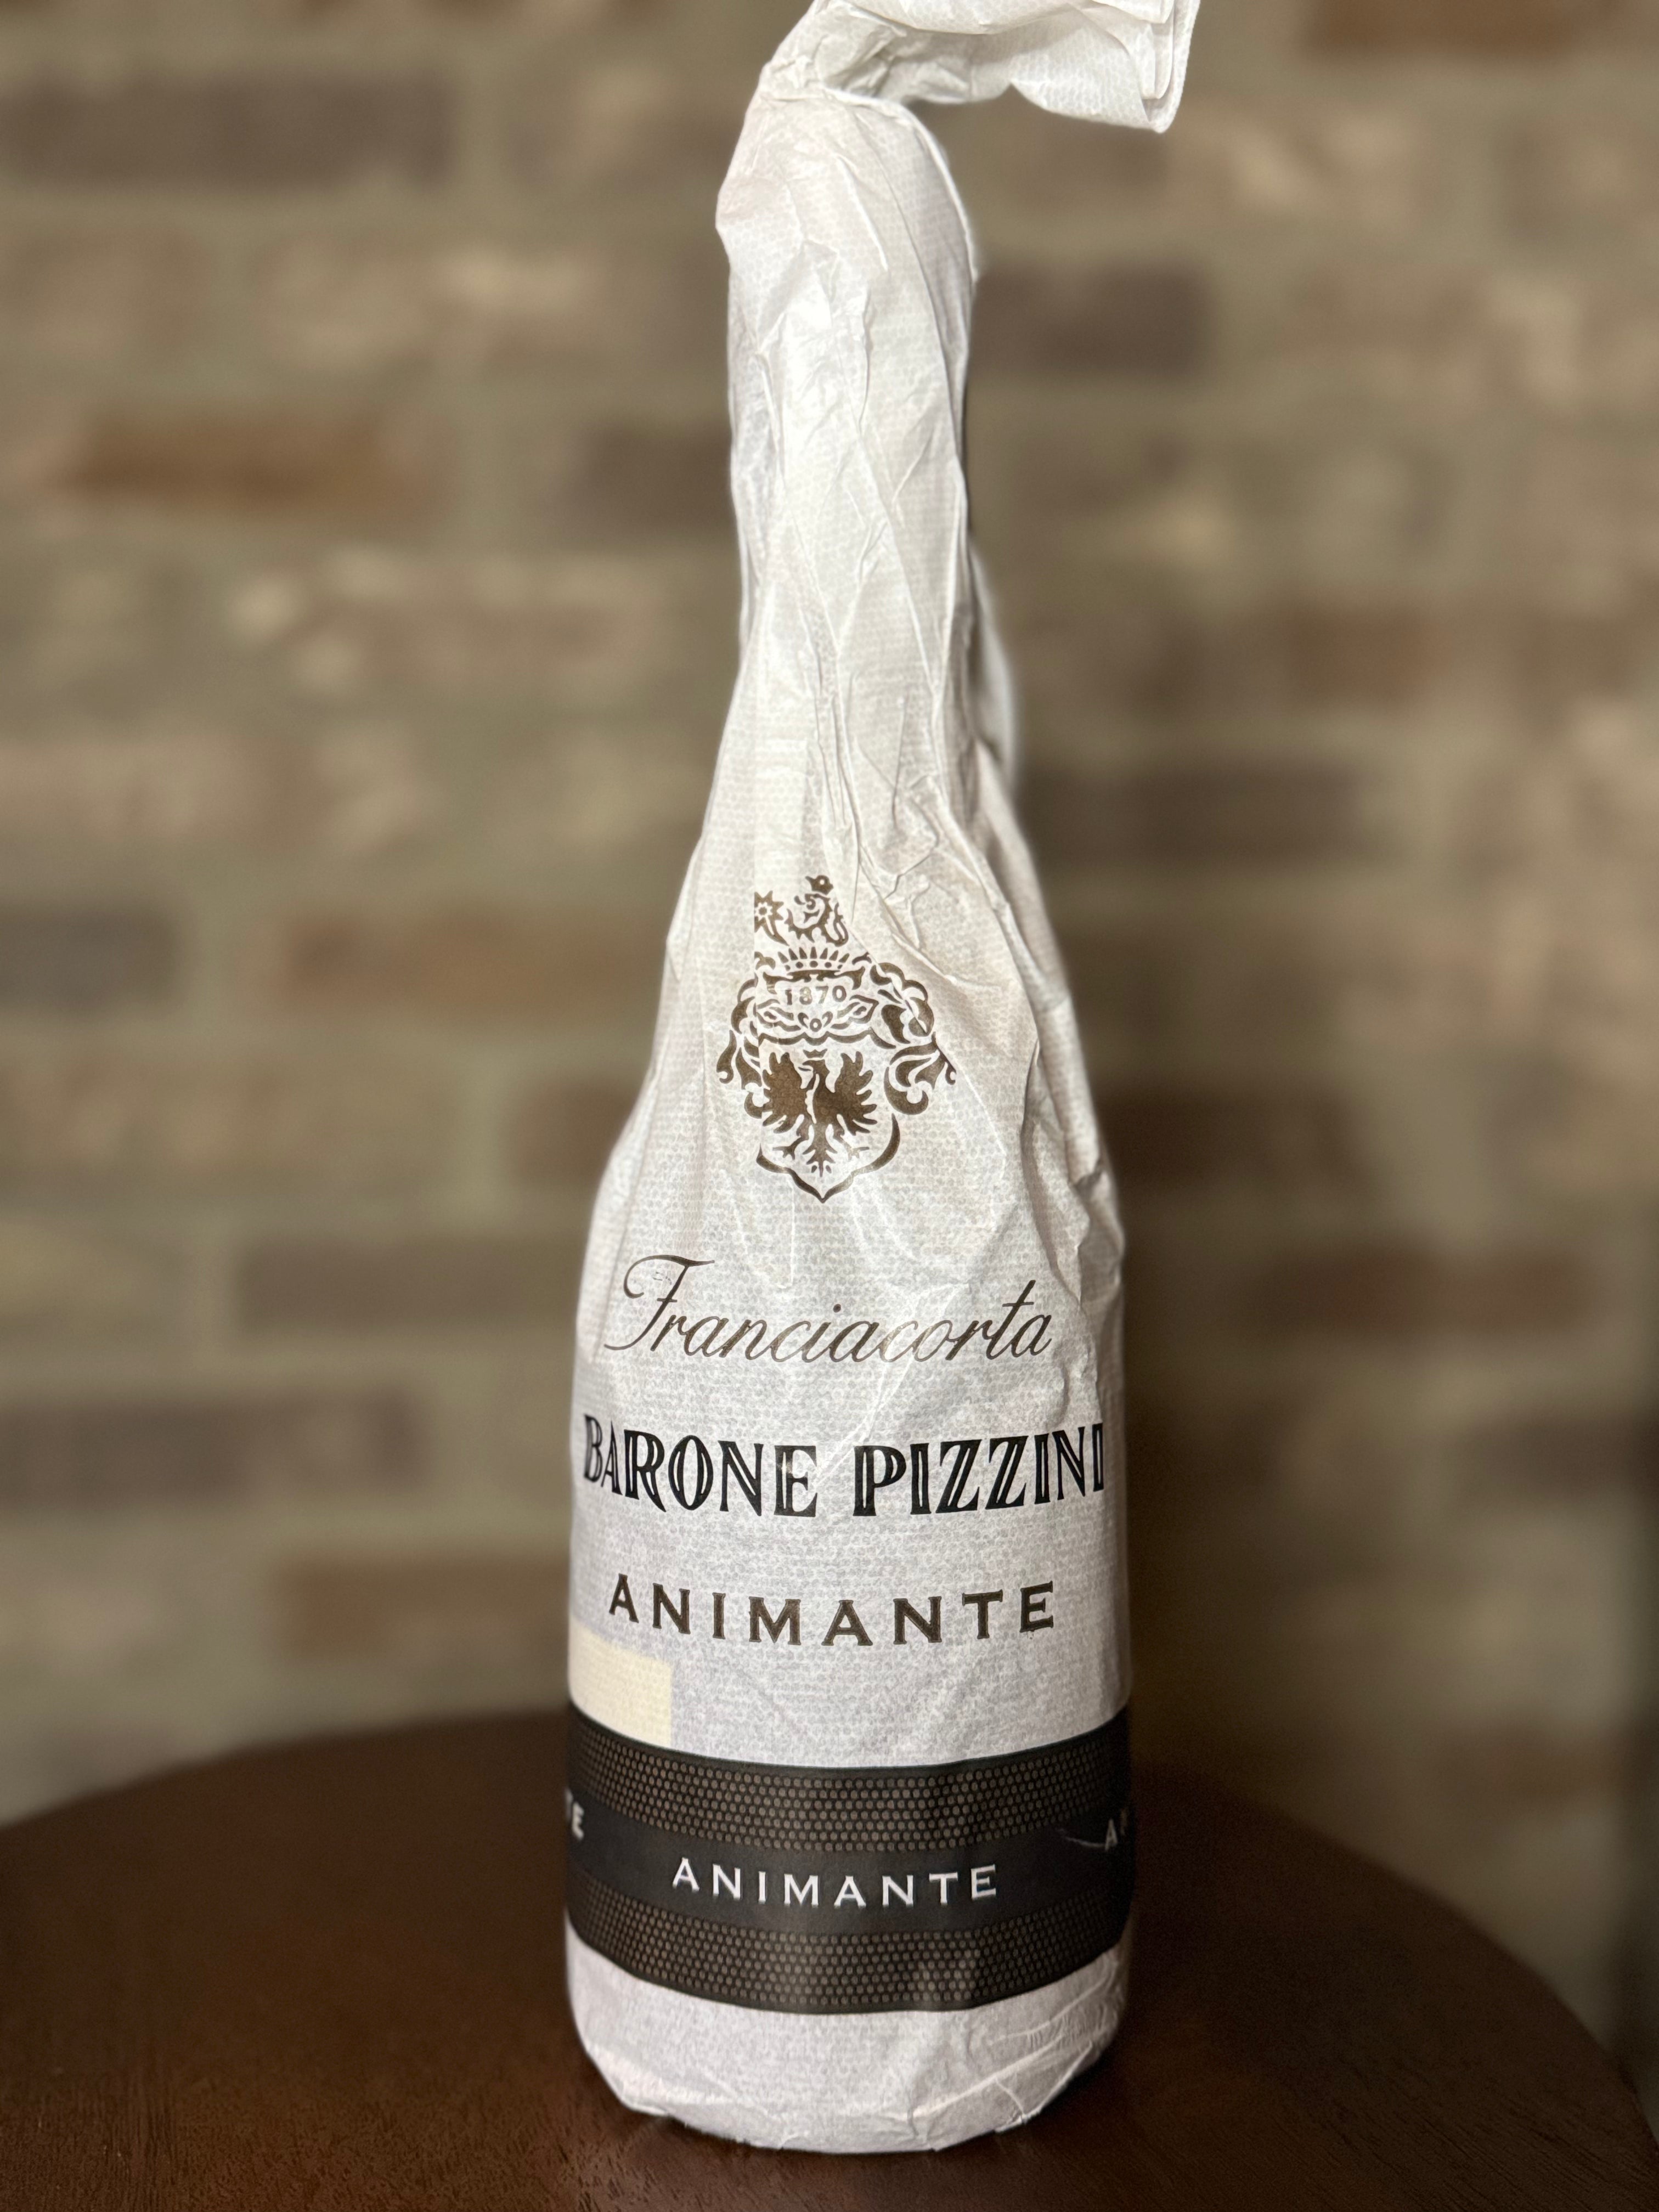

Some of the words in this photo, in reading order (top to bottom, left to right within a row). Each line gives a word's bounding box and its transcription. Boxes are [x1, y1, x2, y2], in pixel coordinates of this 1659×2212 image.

[785, 985, 847, 1006] 1870
[605, 1255, 1051, 1363] Franciacorta
[584, 1414, 819, 1517] BARONE
[853, 1423, 1104, 1517] PIZZINI
[609, 1574, 1054, 1646] ANIMANTE
[672, 1857, 997, 1909] ANIMANTE
